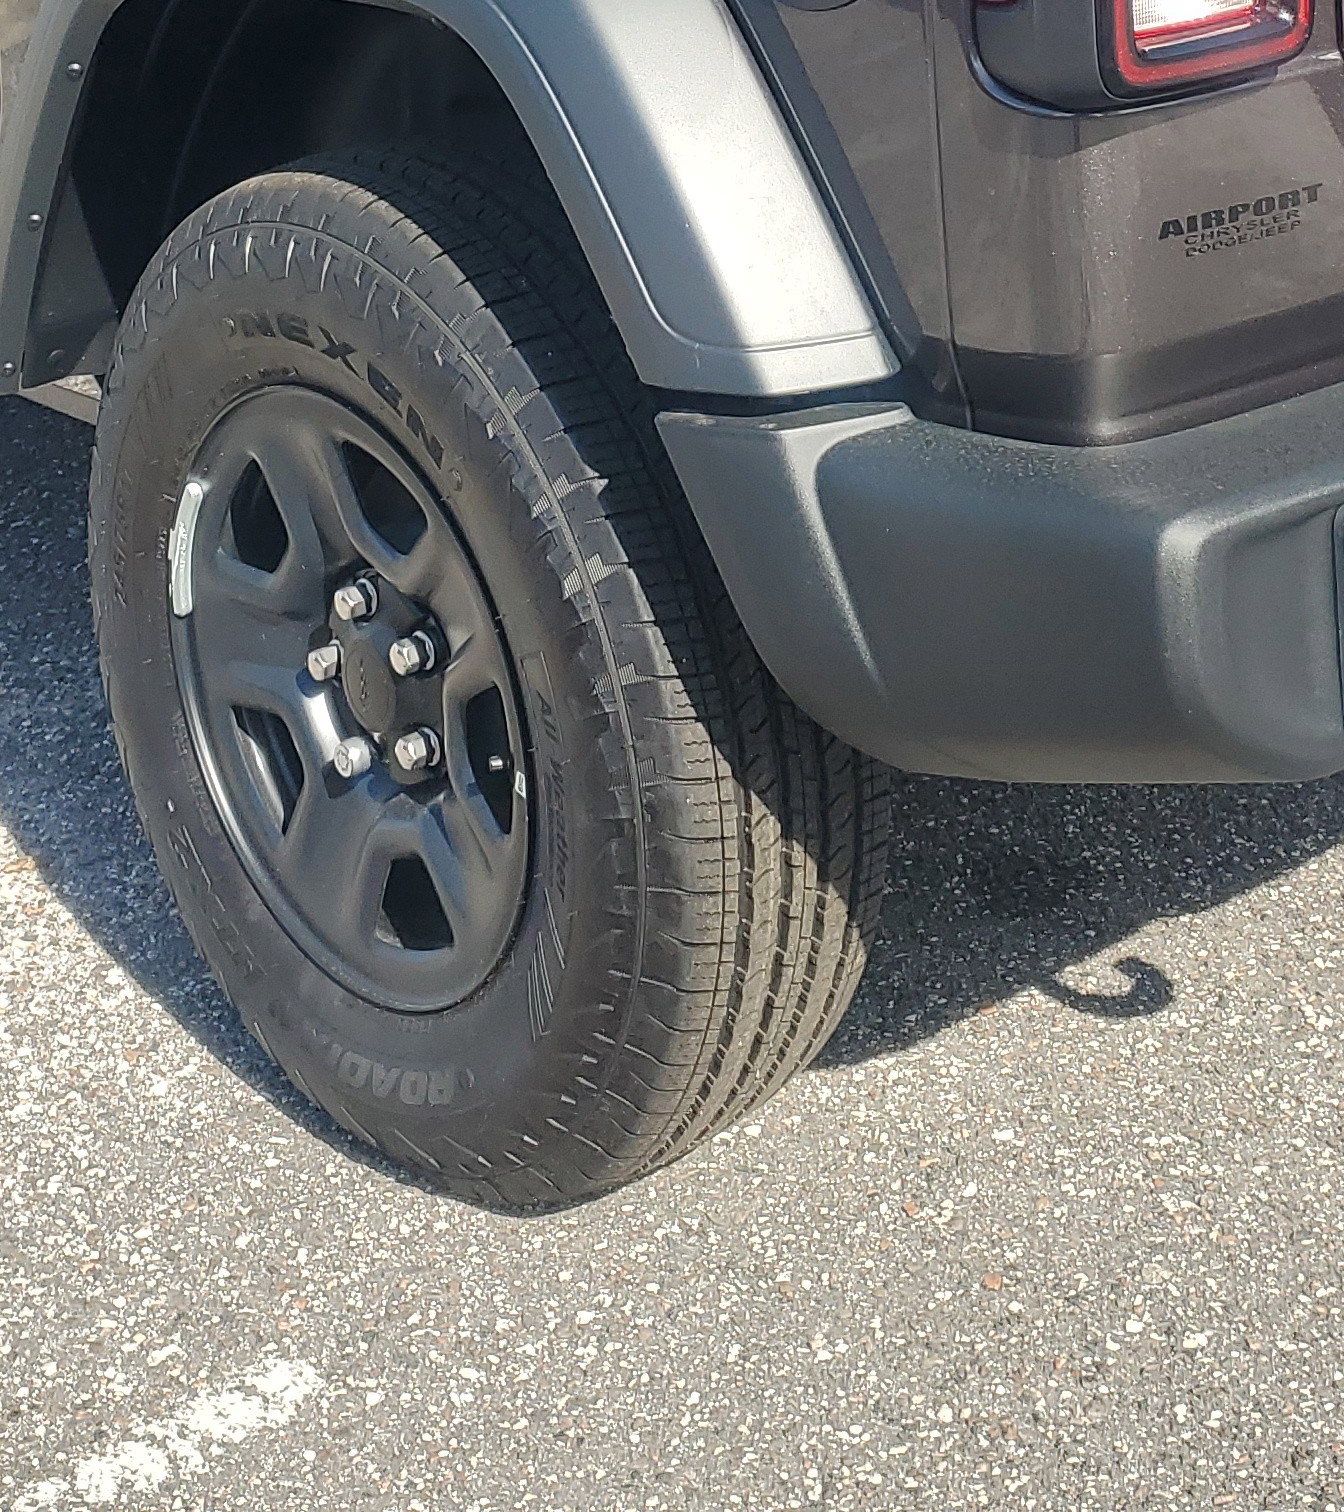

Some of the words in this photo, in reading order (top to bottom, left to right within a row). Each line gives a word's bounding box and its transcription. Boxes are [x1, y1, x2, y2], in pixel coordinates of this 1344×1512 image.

[1158, 183, 1323, 241] AIRPORT
[1184, 209, 1300, 245] CHRYSLER
[240, 312, 445, 471] NEXEN
